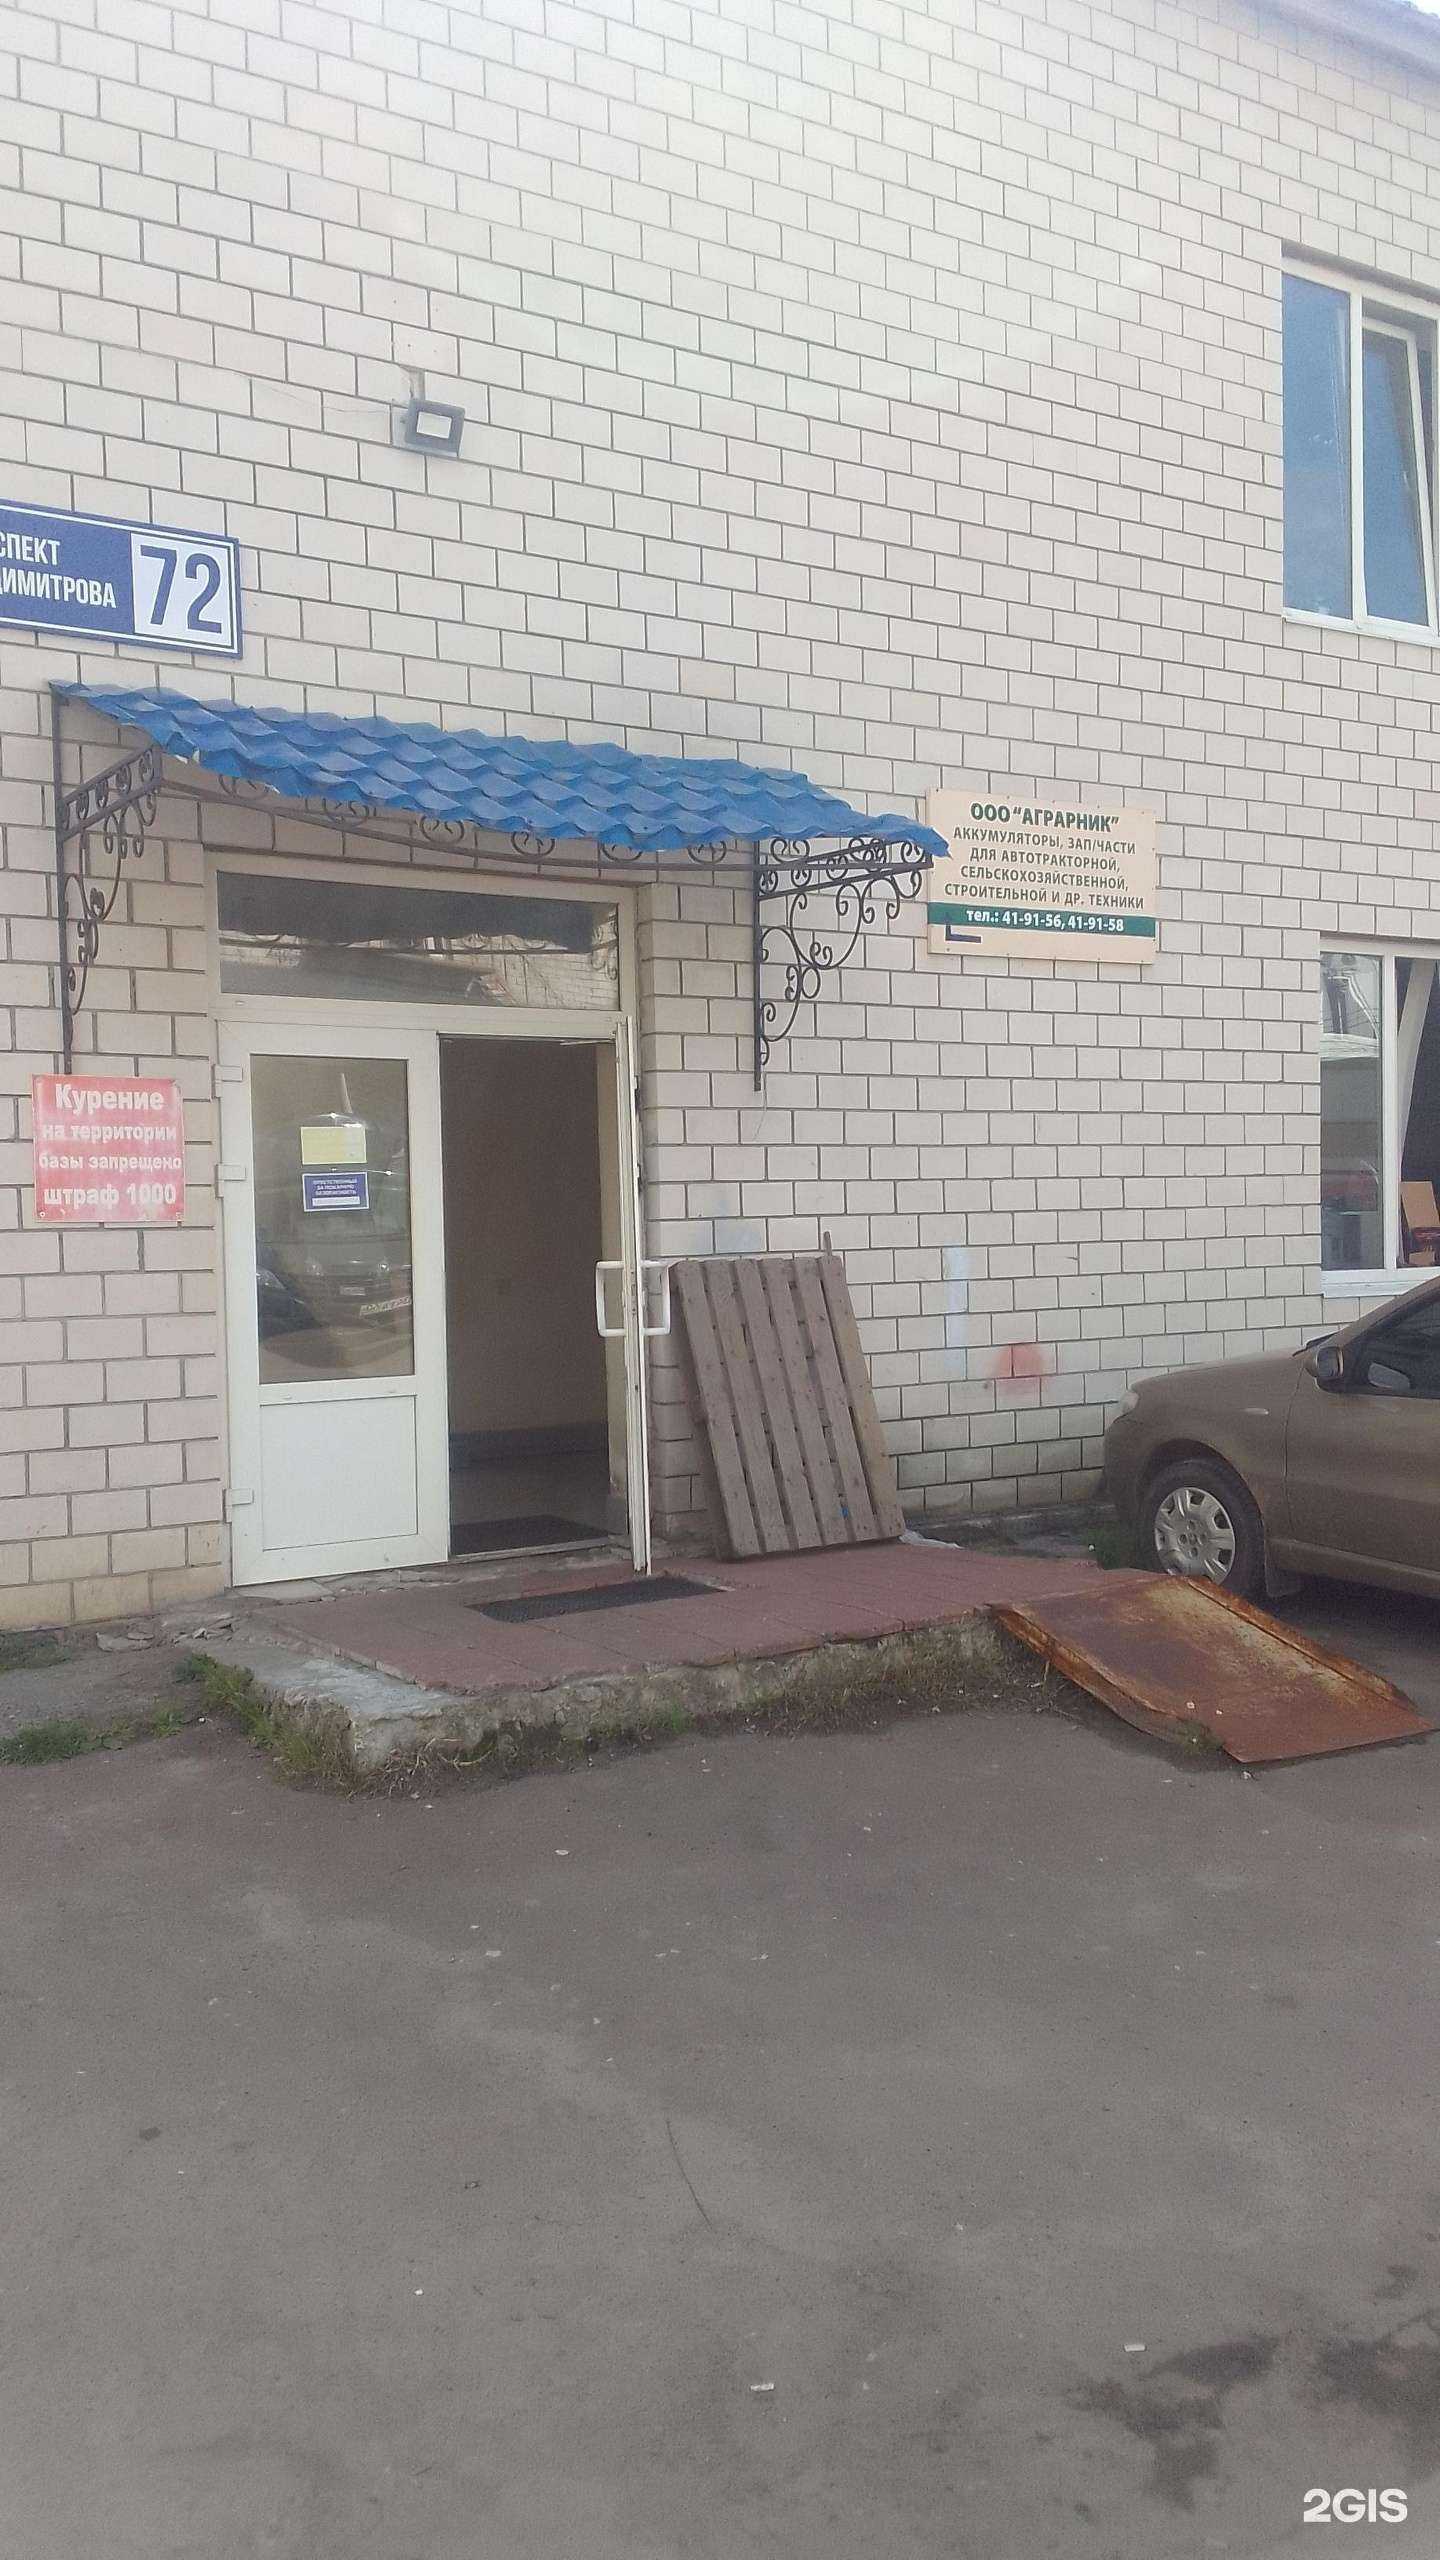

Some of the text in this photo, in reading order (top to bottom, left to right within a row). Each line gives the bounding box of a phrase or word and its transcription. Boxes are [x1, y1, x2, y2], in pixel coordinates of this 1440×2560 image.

[0, 567, 117, 609] ИМИТРОВА
[140, 544, 222, 634] 72
[970, 802, 1011, 823] ООО
[953, 826, 1136, 855] АККУМУЛЯТОРЫ, ЗАП/ЧАСТИ
[970, 847, 1120, 873] ДЛЯ АВТОТРАКТОРНОЙ,
[960, 865, 1129, 892] СЕЛЬСКОХОЗЯЙСТВЕННОЙ,
[944, 883, 1144, 909] СТРОИТЕЛЬНОЙ И ДР. ТЕХНИКИ
[966, 909, 1124, 932] тел.: 41-91-56, 41-91-58
[55, 1083, 164, 1116] Курение
[42, 1124, 177, 1145] на территории
[38, 1151, 182, 1173] базы запрещено
[44, 1182, 177, 1210] штраф 1000
